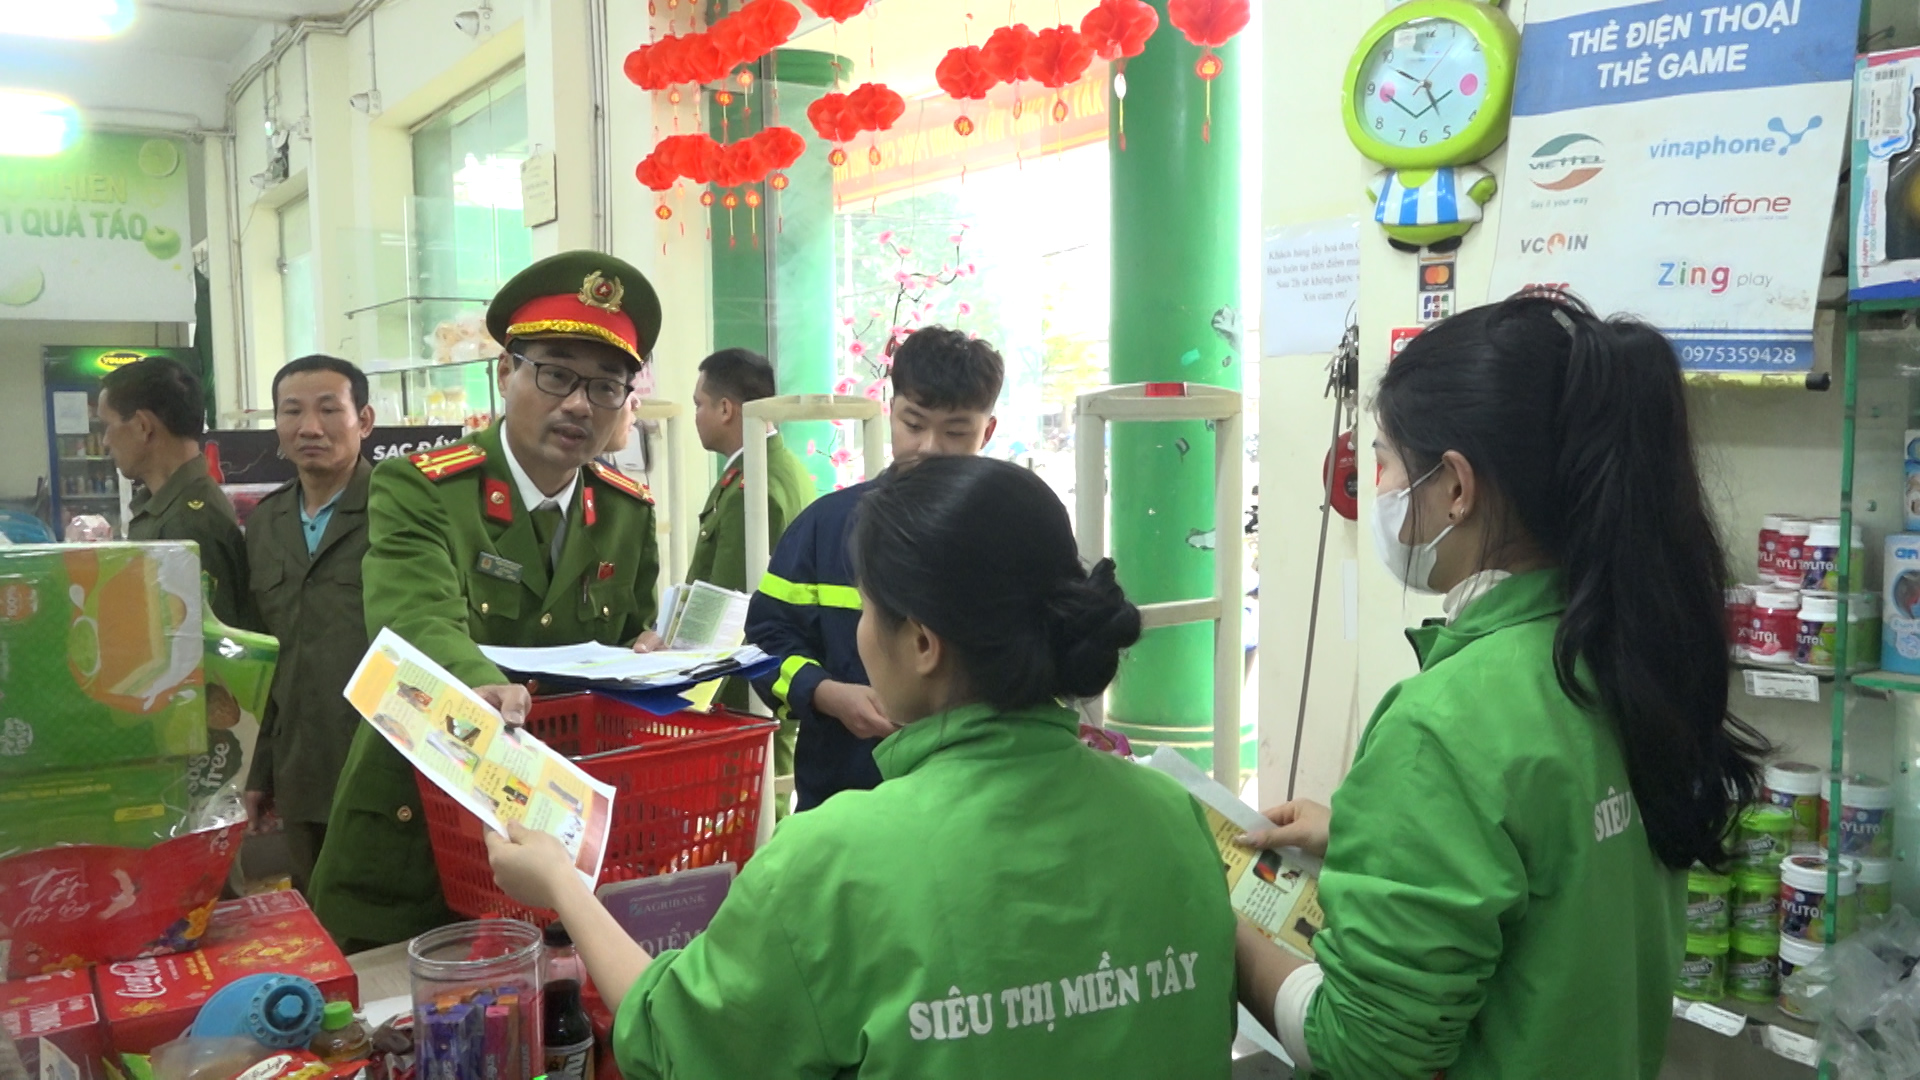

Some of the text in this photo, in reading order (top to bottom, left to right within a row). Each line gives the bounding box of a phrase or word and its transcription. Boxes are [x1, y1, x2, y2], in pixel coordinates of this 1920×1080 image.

[1568, 0, 1801, 57] THẺ ĐIỆN THOẠI
[1597, 43, 1749, 88] THẺ GAME
[1366, 81, 1376, 96] 9
[1375, 116, 1384, 130] 8
[1442, 125, 1451, 140] 5
[1398, 129, 1406, 142] 7
[1419, 129, 1428, 144] 6
[1650, 135, 1776, 160] vinaphone
[1652, 193, 1792, 217] mobifone
[90, 208, 148, 241] TÁO
[1658, 261, 1773, 294] Zing play
[1681, 345, 1796, 364] 0975359428
[199, 741, 230, 787] free
[1594, 786, 1631, 842] SIÊU
[644, 893, 705, 913] AGRIBANK
[908, 945, 1199, 1041] SIÊU THỊ MIỀN TÂY
